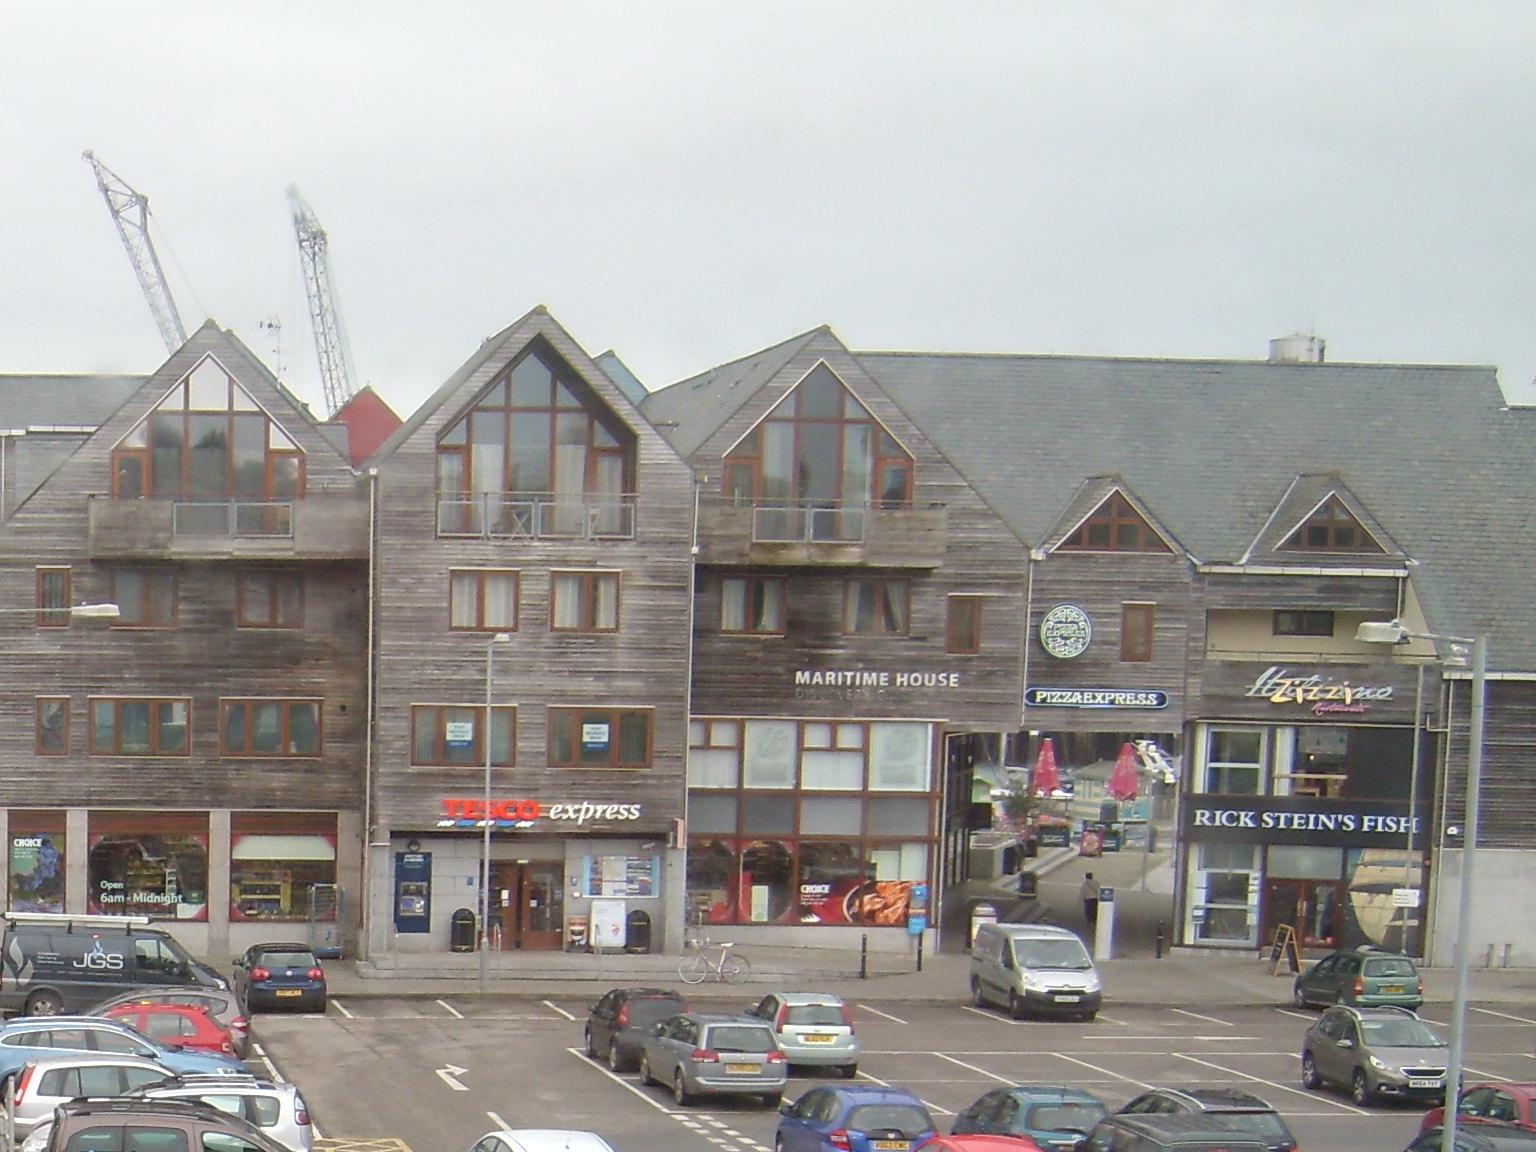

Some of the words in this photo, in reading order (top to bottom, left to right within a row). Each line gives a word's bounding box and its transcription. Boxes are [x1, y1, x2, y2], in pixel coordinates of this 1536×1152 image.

[795, 671, 889, 686] MARITIME
[896, 673, 959, 687] HOUSE
[1035, 691, 1158, 705] PIZZAEXPRESS
[443, 799, 540, 819] TESCO
[550, 802, 640, 825] express
[1193, 809, 1257, 828] RICK
[1261, 811, 1356, 831] STEIN'S
[1361, 815, 1419, 834] FISH
[100, 881, 124, 891] Open
[100, 893, 125, 904] 6am
[133, 893, 183, 907] Midnight
[73, 953, 124, 970] JGS
